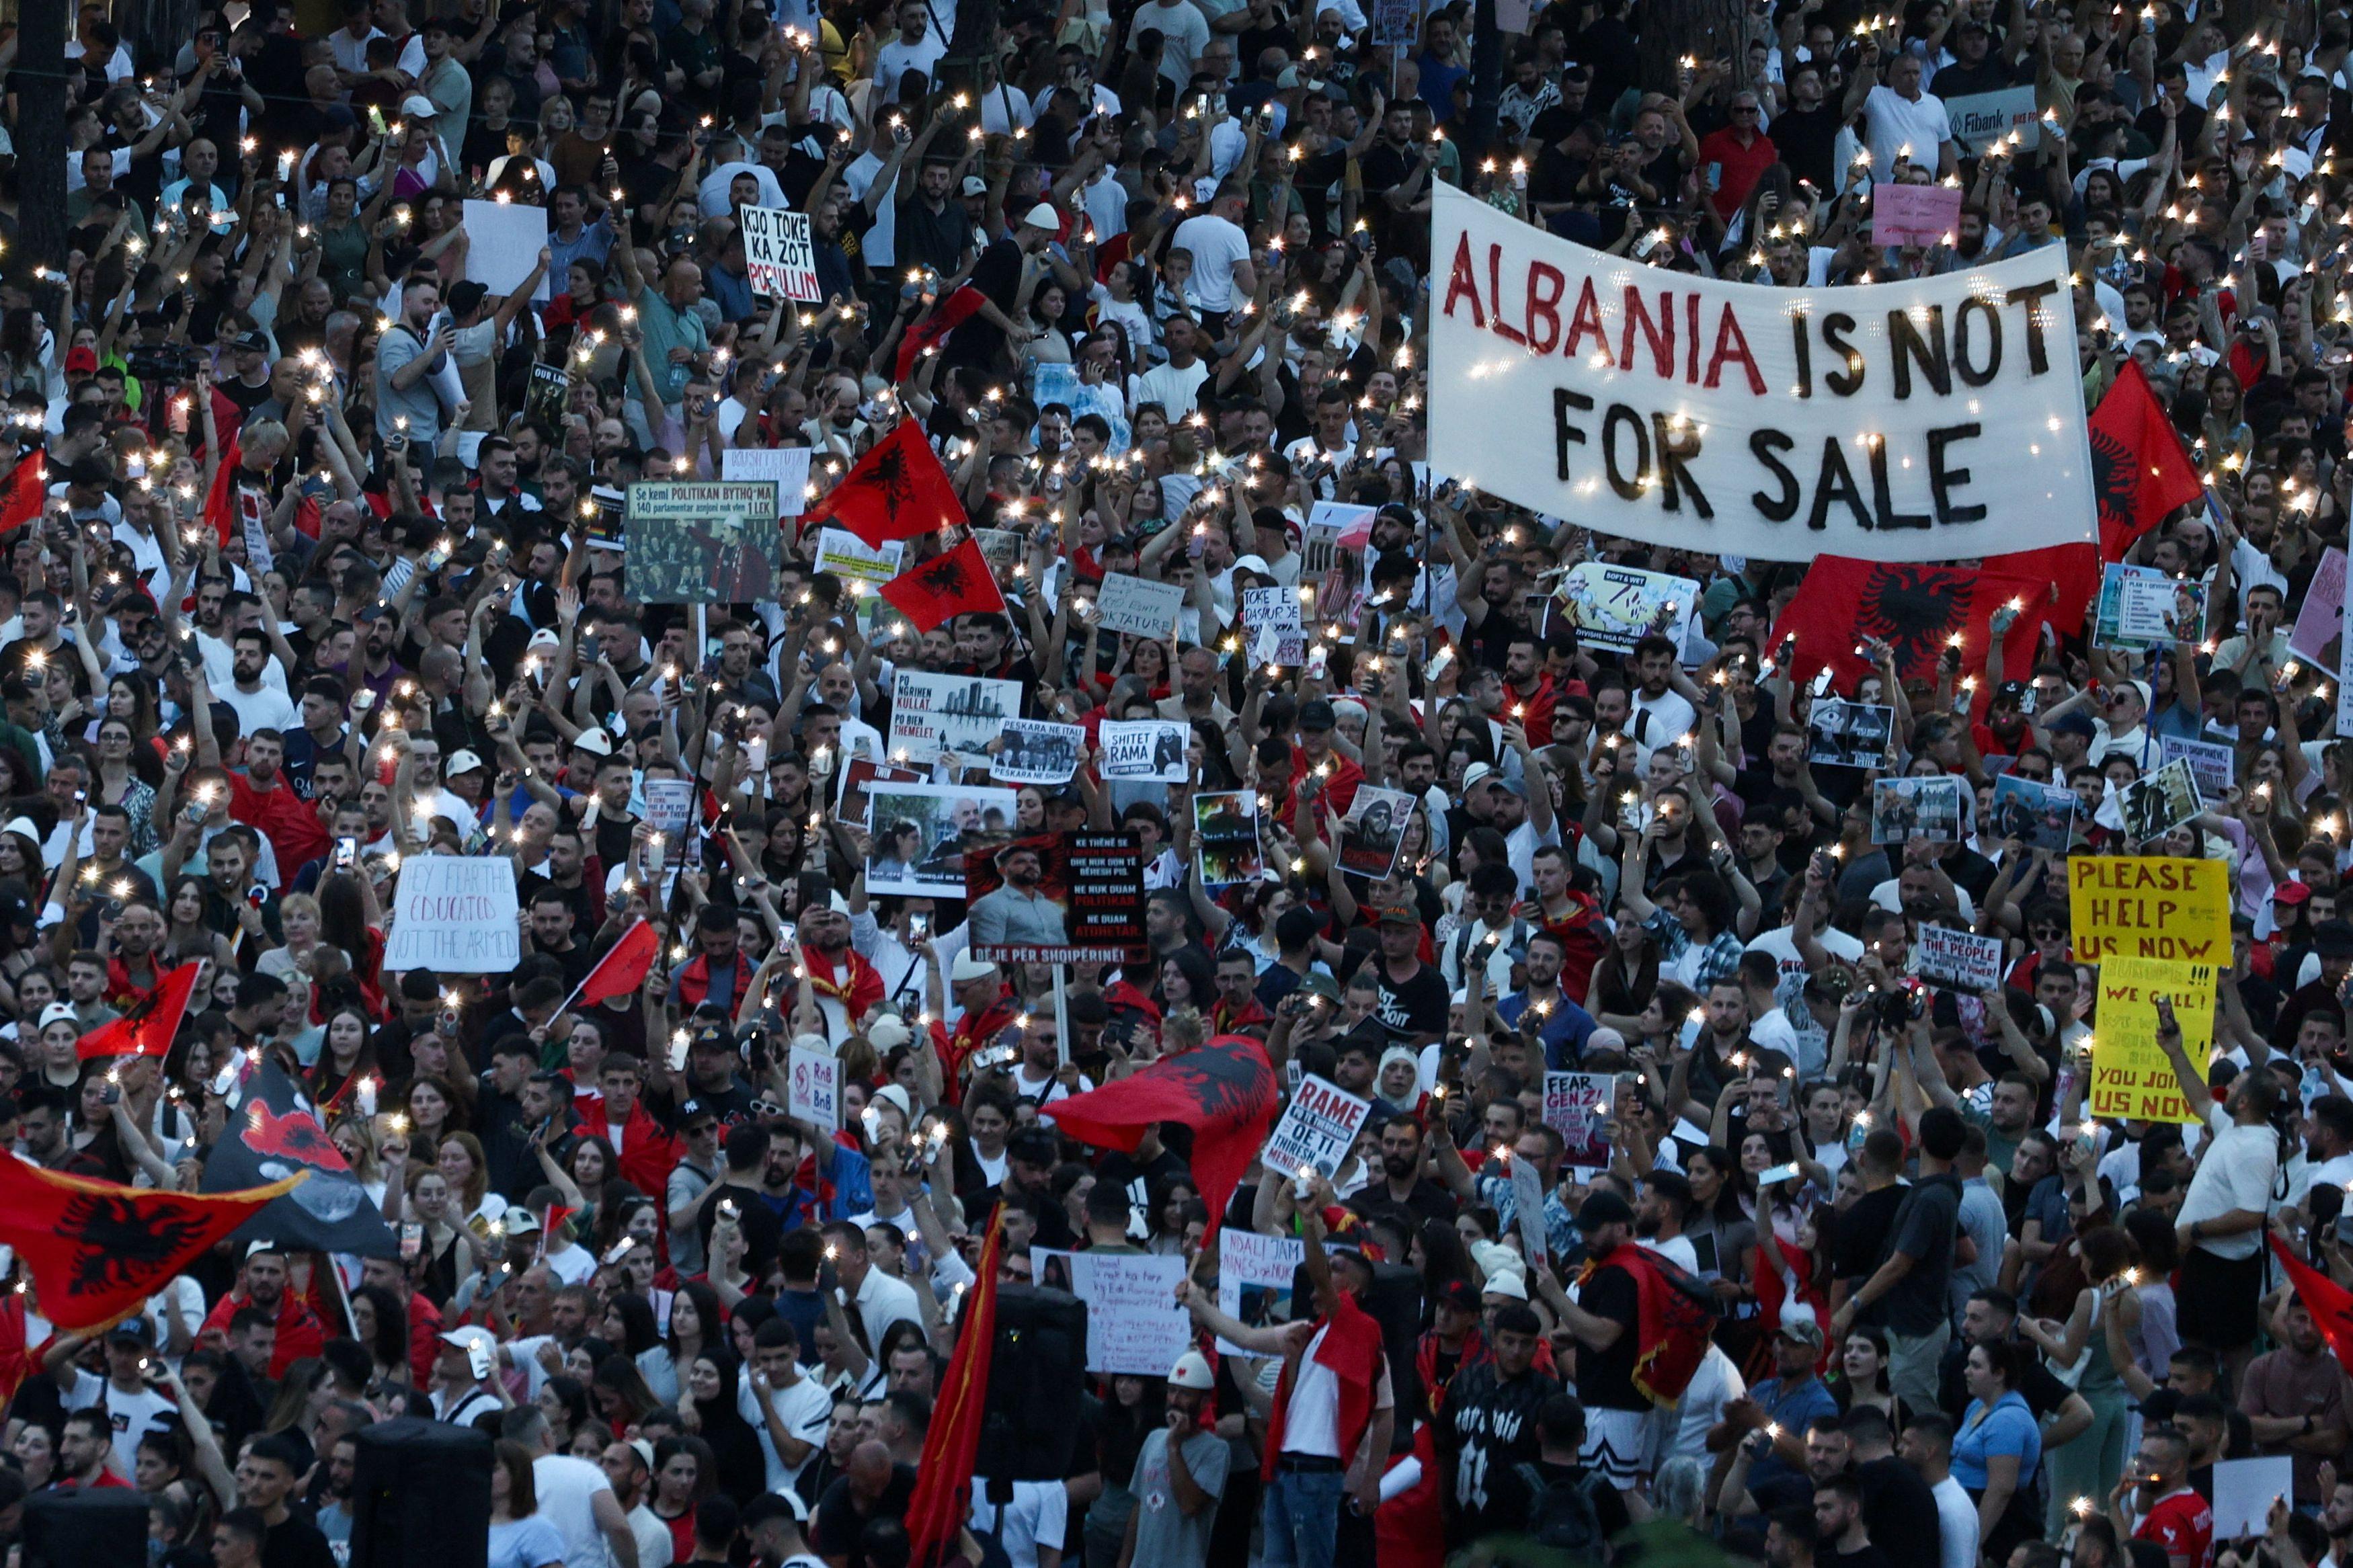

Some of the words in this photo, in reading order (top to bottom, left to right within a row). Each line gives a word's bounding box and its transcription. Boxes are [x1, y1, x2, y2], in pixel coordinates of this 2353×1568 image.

[1964, 109, 2003, 133] Fibank
[743, 208, 768, 236] KJO
[772, 212, 807, 242] TOKË
[752, 236, 773, 262] KA
[778, 239, 809, 267] ZOT
[1443, 229, 1767, 395] ALBANIA
[1791, 309, 1865, 398] IS
[1889, 279, 2057, 400] NOT
[534, 368, 552, 380] OUR
[1554, 387, 1714, 519] FOR
[1749, 422, 1987, 531] SALE
[636, 487, 647, 501] Se
[672, 487, 719, 501] POLITIKAN
[638, 502, 651, 513] 140
[747, 502, 752, 515] 1
[754, 502, 770, 514] LEK
[1630, 576, 1645, 585] WET
[1281, 587, 1291, 604] E
[1103, 610, 1170, 633] IKTATURE
[899, 675, 910, 686] PO
[898, 686, 932, 698] NGRIHEN
[896, 697, 932, 711] KULLAT.
[895, 713, 905, 725] PO
[907, 714, 924, 726] BIEN
[1004, 720, 1047, 733] PESKARA
[1062, 727, 1082, 737] ITALI
[894, 725, 935, 739] THEMELET.
[1112, 732, 1151, 746] SHITET
[1110, 745, 1148, 763] RAMA
[994, 767, 1033, 779] PESKARA
[1070, 857, 1086, 866] DHE
[1088, 858, 1106, 866] NUK
[446, 864, 480, 893] FEAR
[482, 864, 511, 893] THE
[2077, 861, 2198, 891] PLEASE
[1088, 884, 1108, 895] NUK
[1109, 884, 1136, 895] DUAM
[410, 895, 496, 921] EDUCATED
[2091, 898, 2178, 929] HELP
[1101, 915, 1127, 924] DUAM
[428, 930, 461, 959] THE
[465, 930, 518, 960] ARMED
[1923, 927, 1939, 940] THE
[1941, 931, 1974, 946] POWER
[1977, 938, 1988, 948] OF
[2079, 935, 2118, 960] US
[2139, 936, 2213, 960] NOW
[1012, 946, 1037, 962] PËR
[1041, 946, 1125, 963] SHQIPËRINË!
[1925, 938, 1946, 953] THE
[1950, 942, 1995, 962] PEOPLE
[2106, 985, 2139, 1002] WE
[2149, 989, 2195, 1009] CLL
[813, 1062, 832, 1084] RnB
[2098, 1066, 2137, 1087] YOU
[1547, 1075, 1593, 1094] FEAR
[813, 1089, 831, 1111] BnB
[1295, 1080, 1365, 1131] RAME
[1546, 1091, 1579, 1108] GEN
[2093, 1090, 2131, 1114] US
[1291, 1122, 1316, 1147] QE
[1317, 1134, 1335, 1155] TI
[1271, 1239, 1299, 1261] JAM
